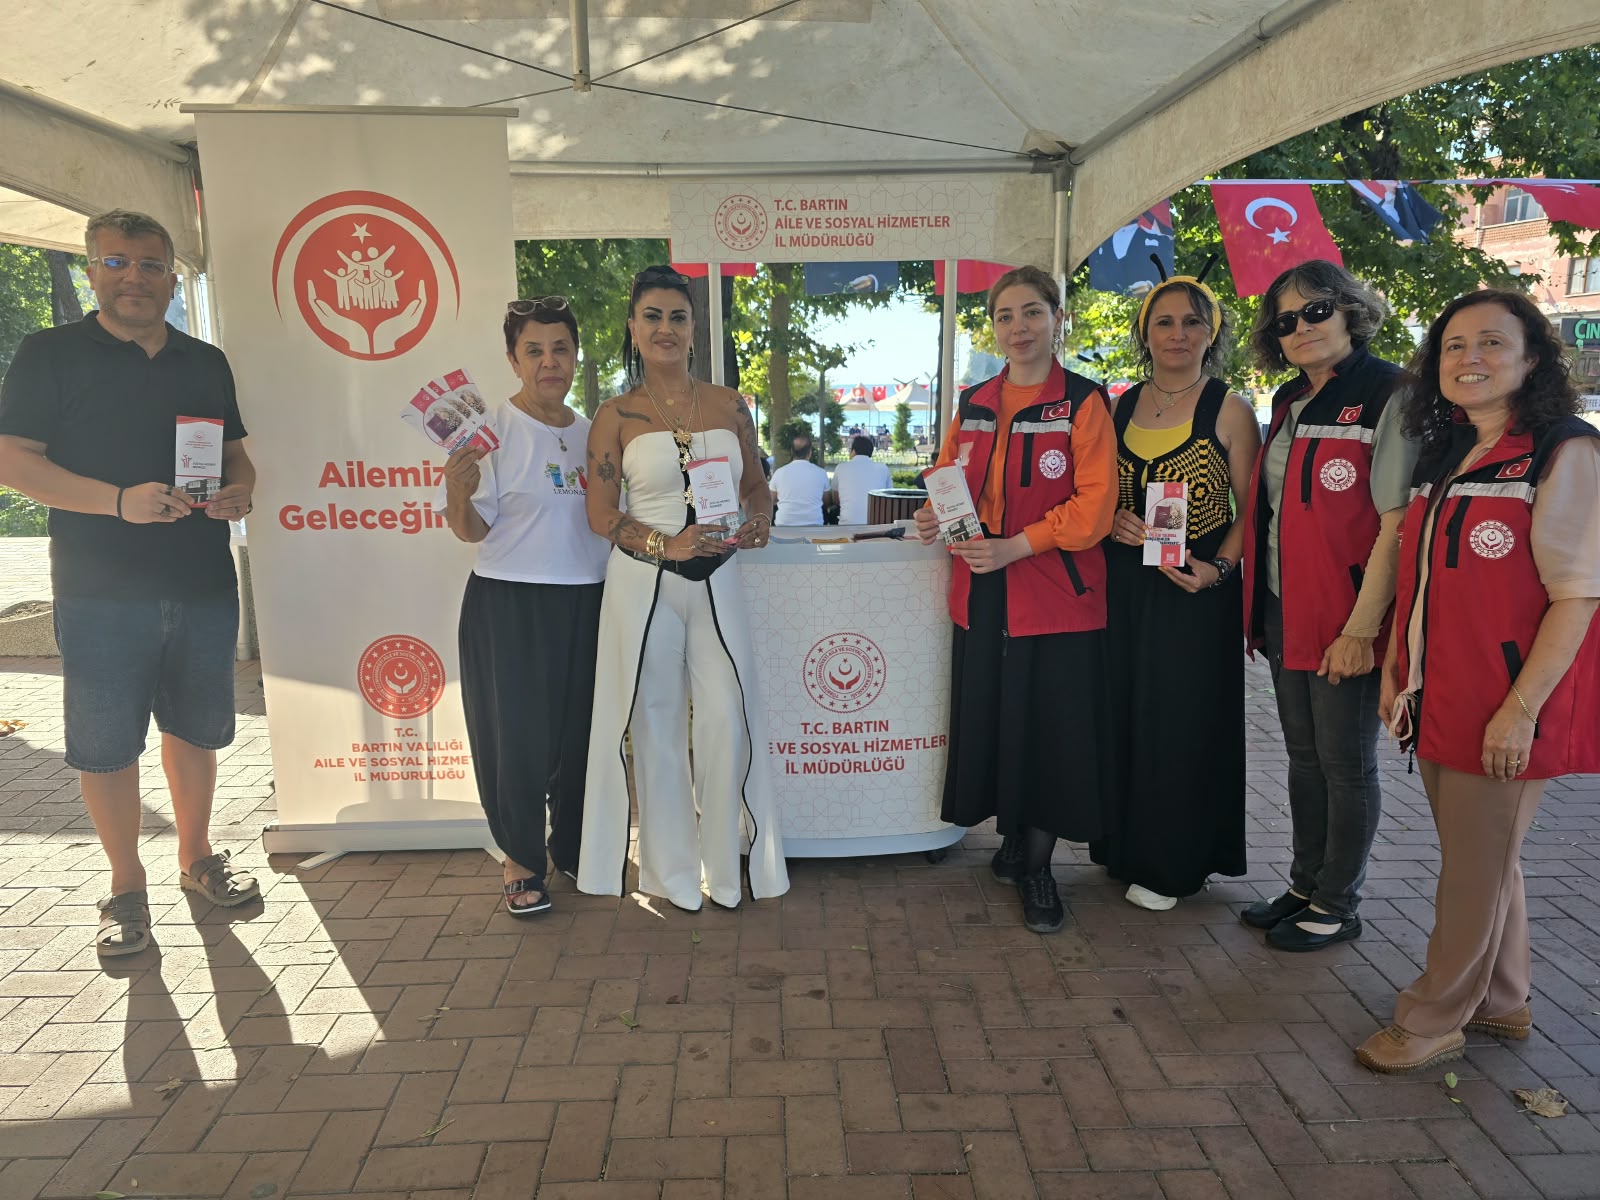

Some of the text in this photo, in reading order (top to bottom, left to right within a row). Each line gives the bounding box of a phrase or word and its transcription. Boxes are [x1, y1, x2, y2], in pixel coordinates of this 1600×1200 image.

[774, 199, 848, 211] T.C. BARTIN
[775, 213, 950, 230] AİLE VE SOSYAL HİZMETLER
[775, 232, 874, 248] İL MÜDÜRLÜĞÜ
[394, 727, 418, 738] T.C.
[801, 720, 889, 735] T.C. BARTIN
[352, 739, 463, 752] BARTIN VALİLİĞİ
[776, 742, 796, 754] VE
[800, 741, 860, 754] SOSYAL
[864, 734, 947, 753] HİZMETLER
[313, 758, 345, 768] AİLE
[349, 757, 367, 767] VE
[370, 756, 423, 767] SOSYAL
[786, 756, 905, 775] İL MÜDÜRLÜĞÜ
[354, 772, 366, 782] İL
